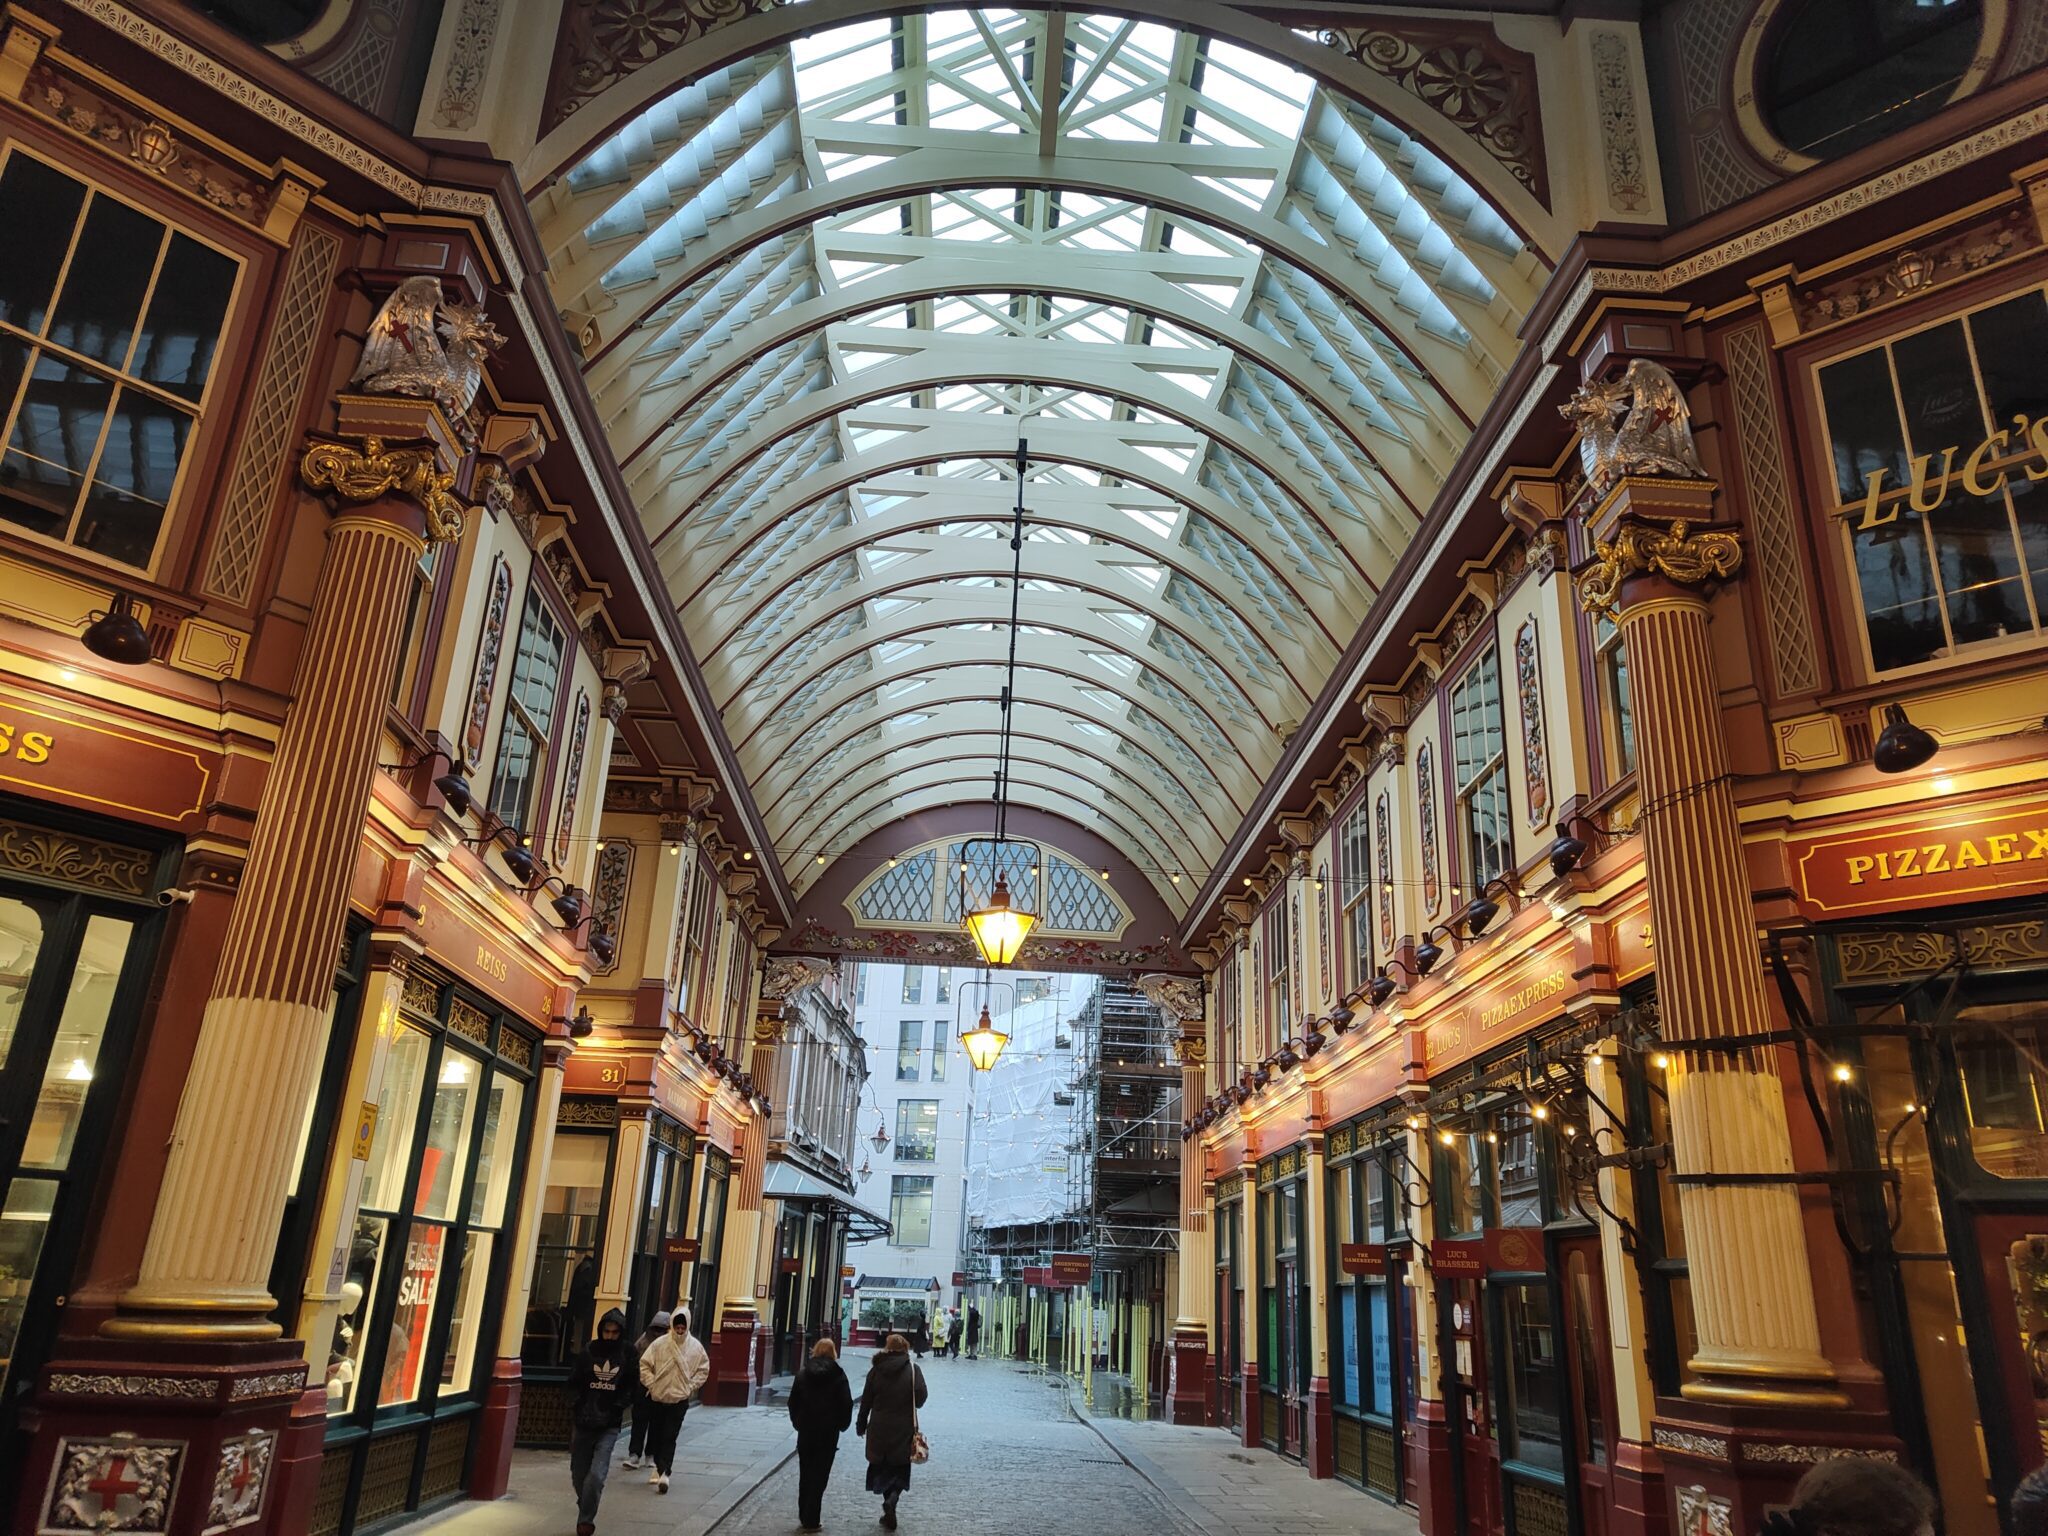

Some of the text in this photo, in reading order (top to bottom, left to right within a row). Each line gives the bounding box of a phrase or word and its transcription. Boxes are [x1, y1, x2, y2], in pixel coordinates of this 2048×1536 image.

[476, 945, 507, 982] REISS
[542, 995, 551, 1015] 26
[1481, 969, 1565, 1032] PIZZAEXPRESS
[1437, 1026, 1461, 1055] LUC'S
[601, 1068, 619, 1082] 31
[669, 1245, 693, 1253] Barbour
[1446, 1250, 1468, 1259] LUC'S
[1436, 1260, 1480, 1269] BRASSERIE
[589, 1381, 616, 1391] adidas
